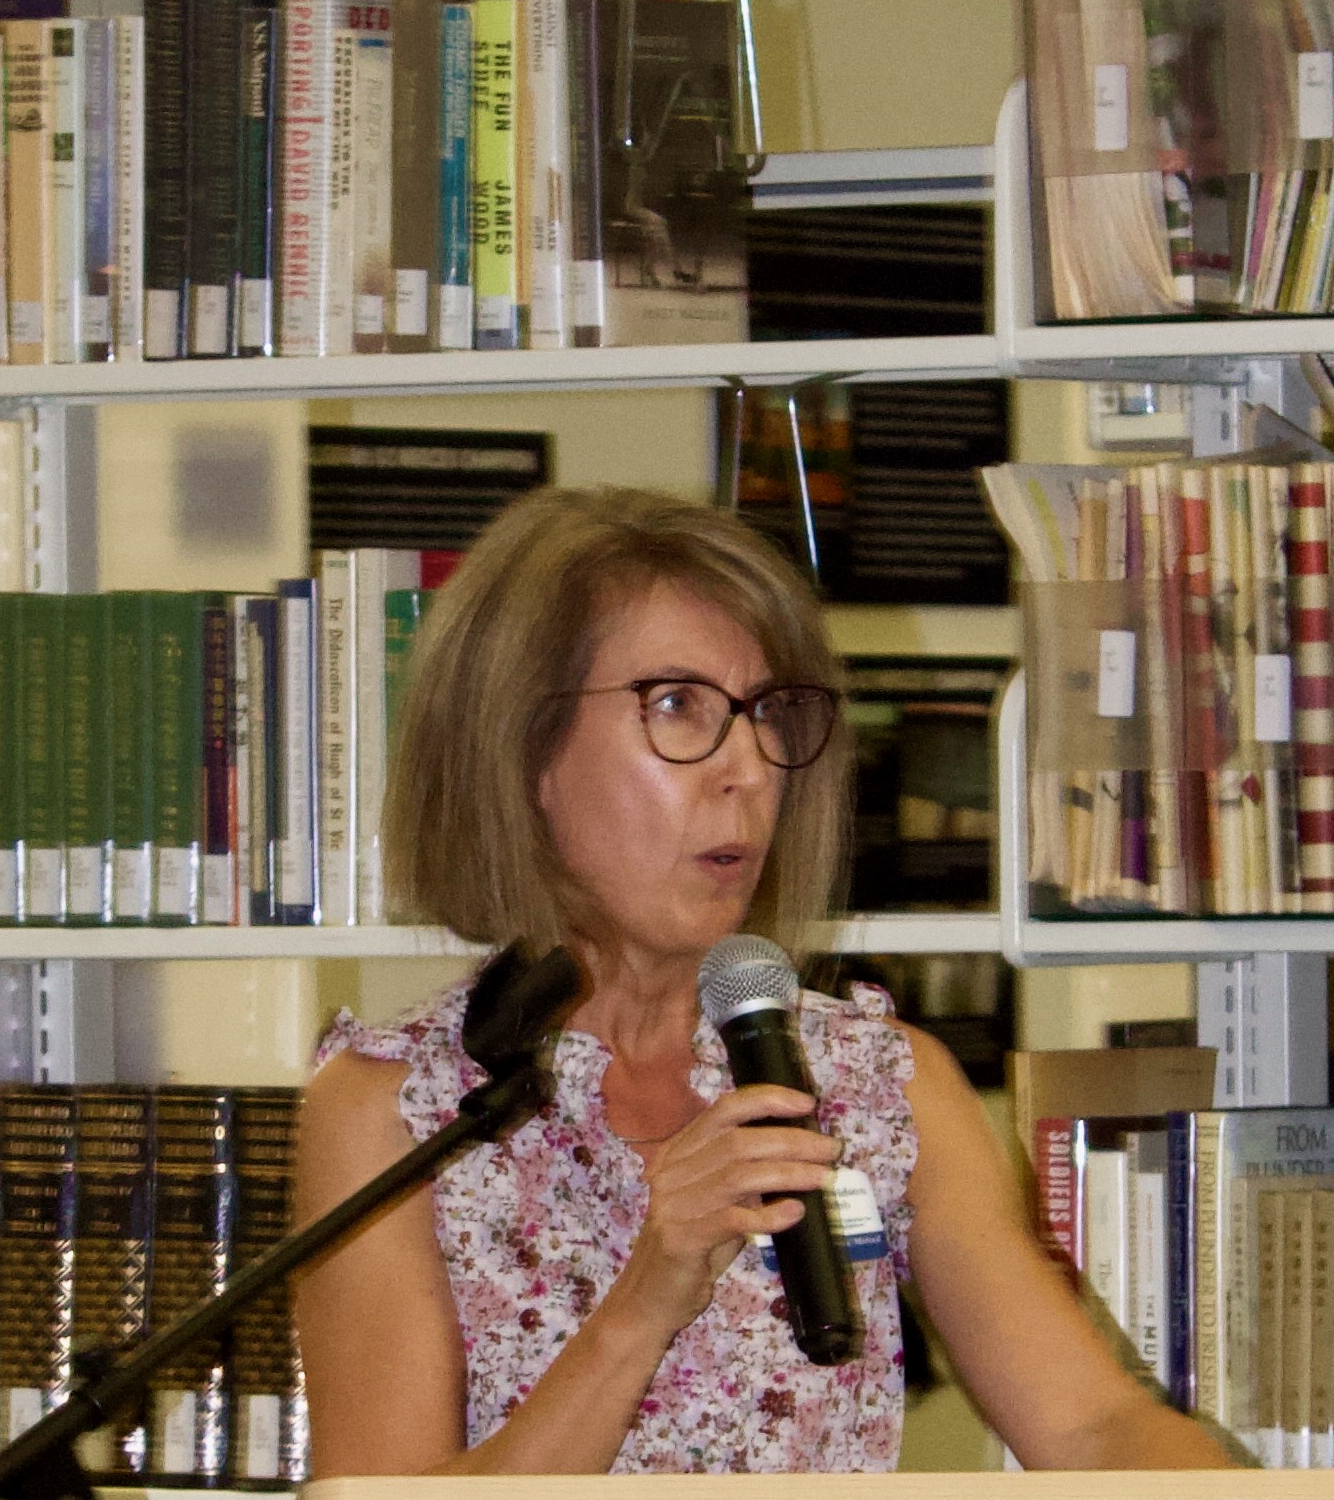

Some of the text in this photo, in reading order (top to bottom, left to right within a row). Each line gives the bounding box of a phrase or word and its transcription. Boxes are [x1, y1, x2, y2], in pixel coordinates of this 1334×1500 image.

[494, 40, 513, 132] THE FUN
[289, 130, 312, 201] DAVID
[494, 179, 513, 256] JAMES
[328, 597, 344, 621] The
[328, 722, 344, 736] of
[325, 743, 344, 780] Hugh
[328, 787, 344, 800] of
[329, 808, 344, 821] St
[1275, 1123, 1328, 1153] FROM
[1047, 1130, 1073, 1224] SOLDIERS
[1198, 1209, 1216, 1296] PLUNDER
[1198, 1301, 1216, 1328] TO
